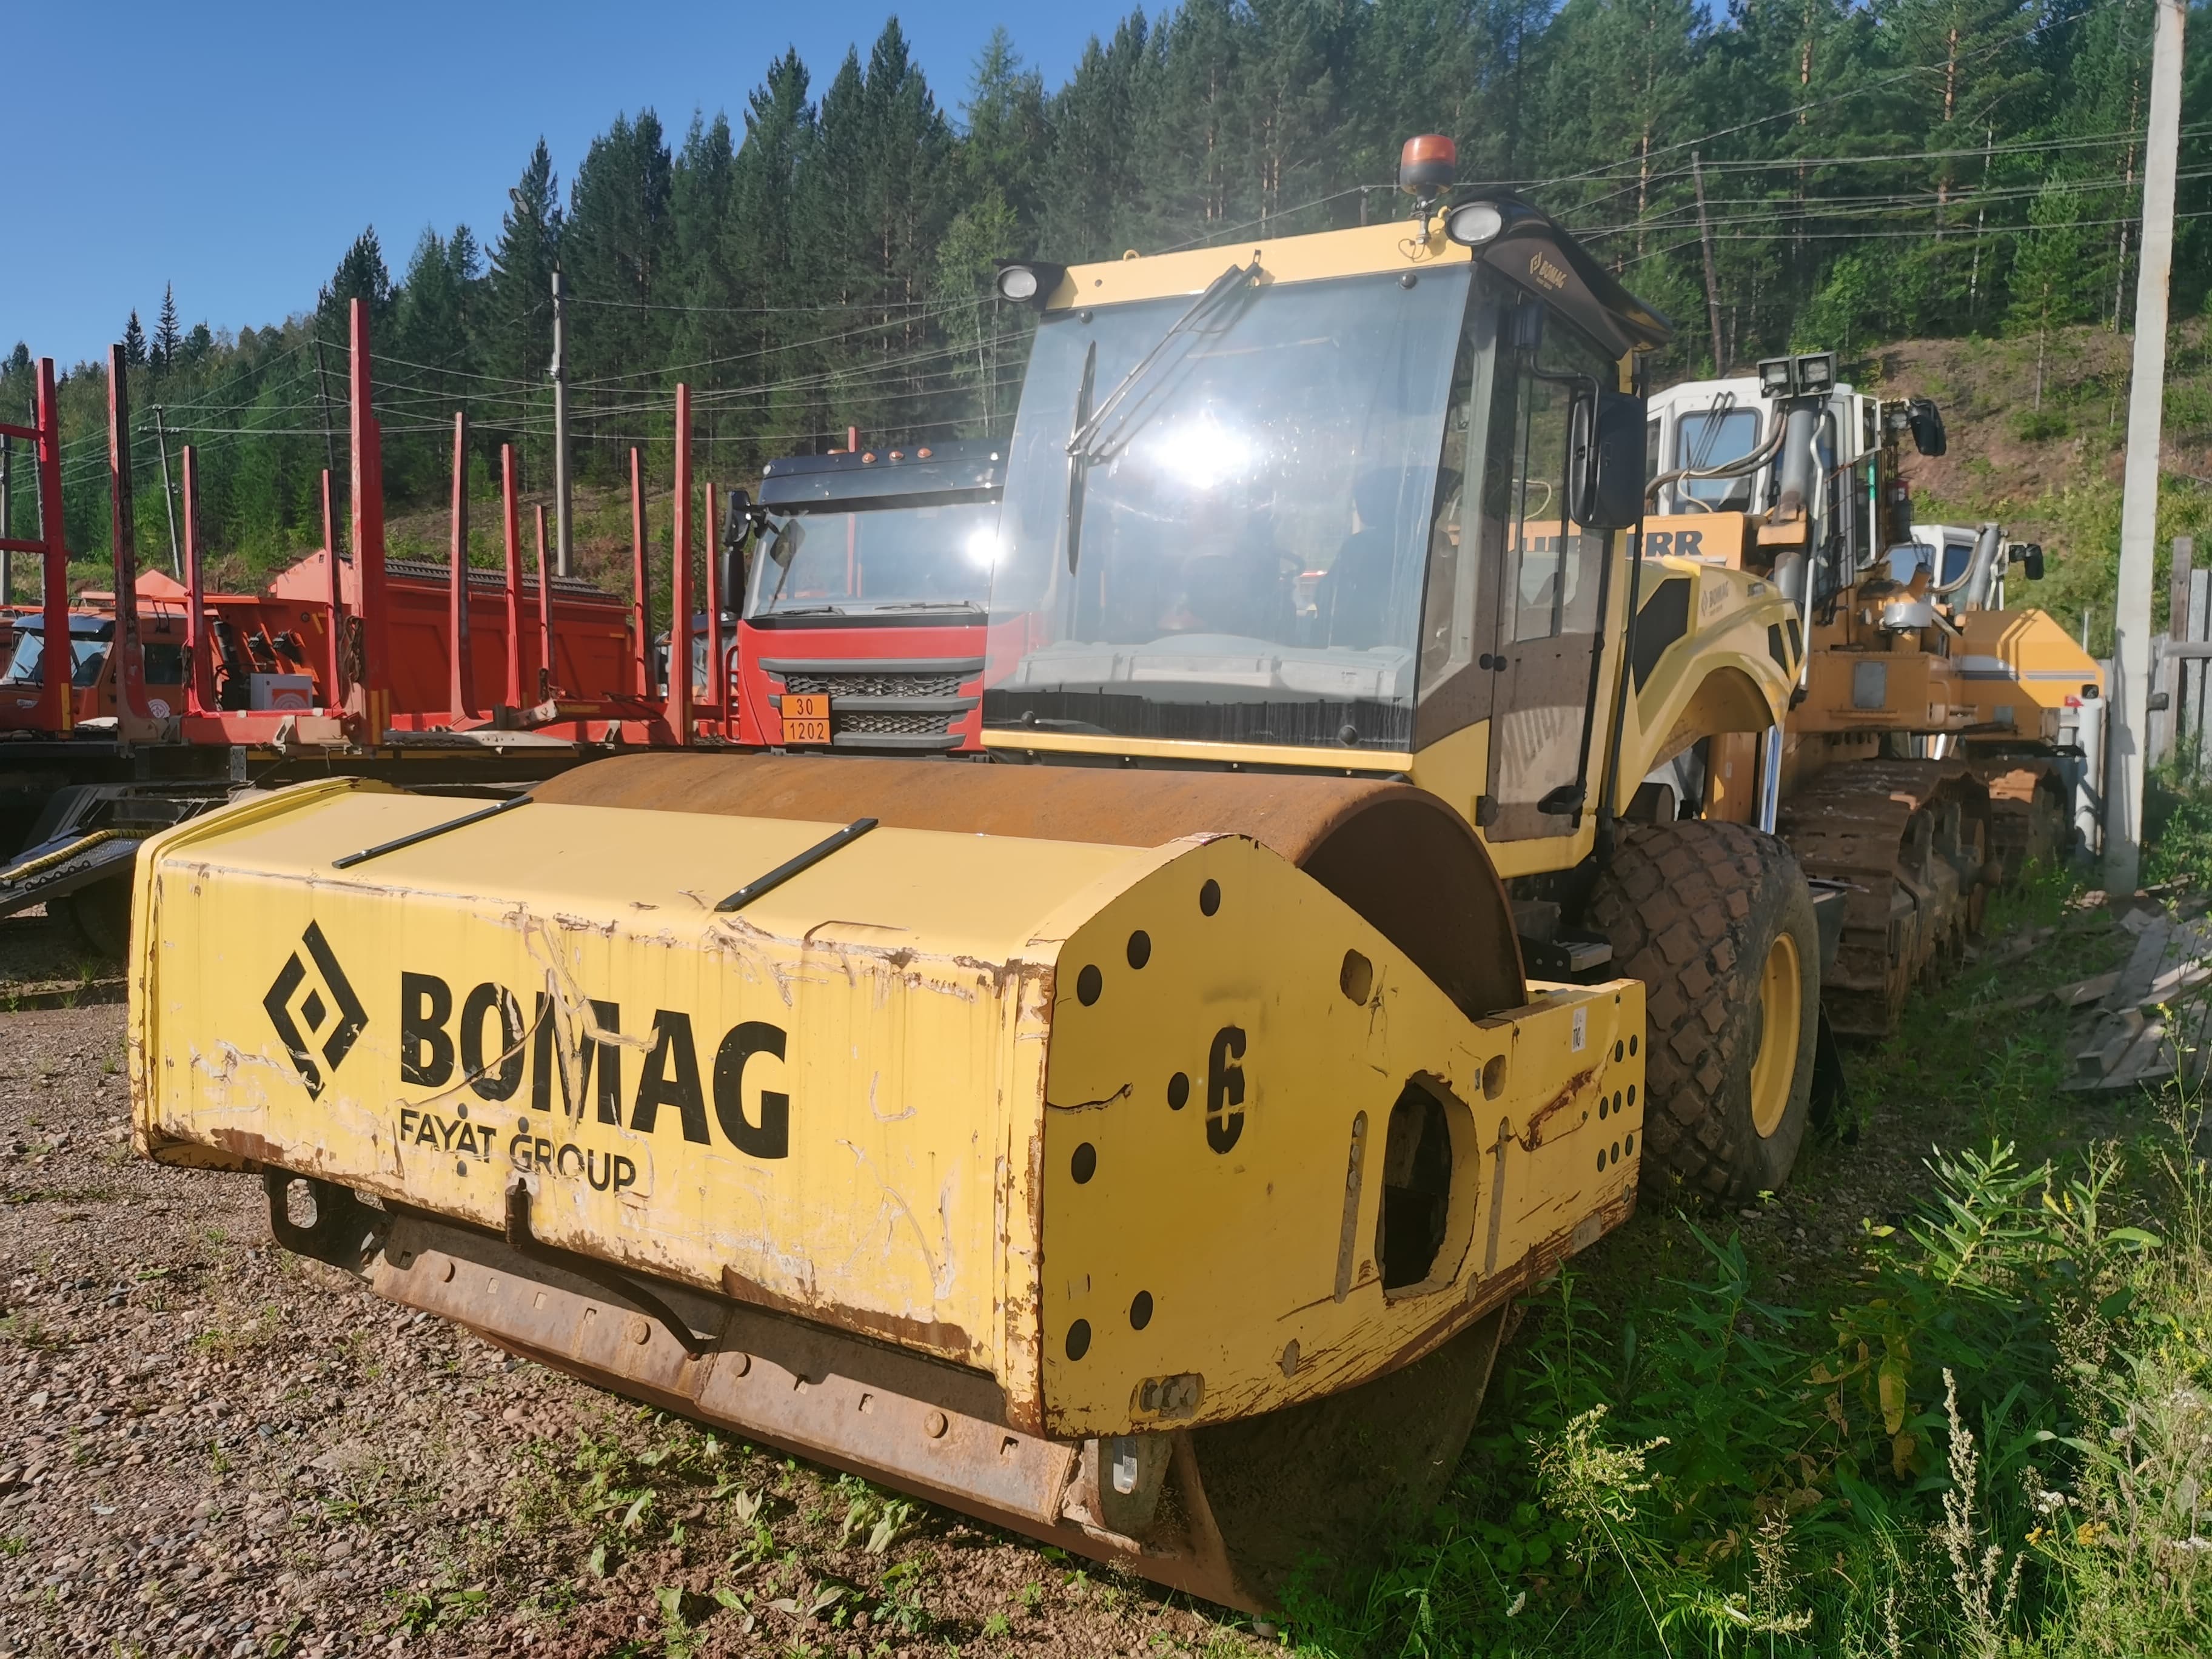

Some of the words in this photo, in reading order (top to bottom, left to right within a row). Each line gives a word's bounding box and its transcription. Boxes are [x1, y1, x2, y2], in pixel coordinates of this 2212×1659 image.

[1539, 260, 1567, 289] BOMAG
[790, 722, 825, 740] 1202
[796, 698, 813, 716] 30
[401, 971, 789, 1159] BOMAG
[1206, 1024, 1247, 1155] 6
[400, 1108, 497, 1164] FAYAT
[509, 1133, 637, 1194] GROUP
